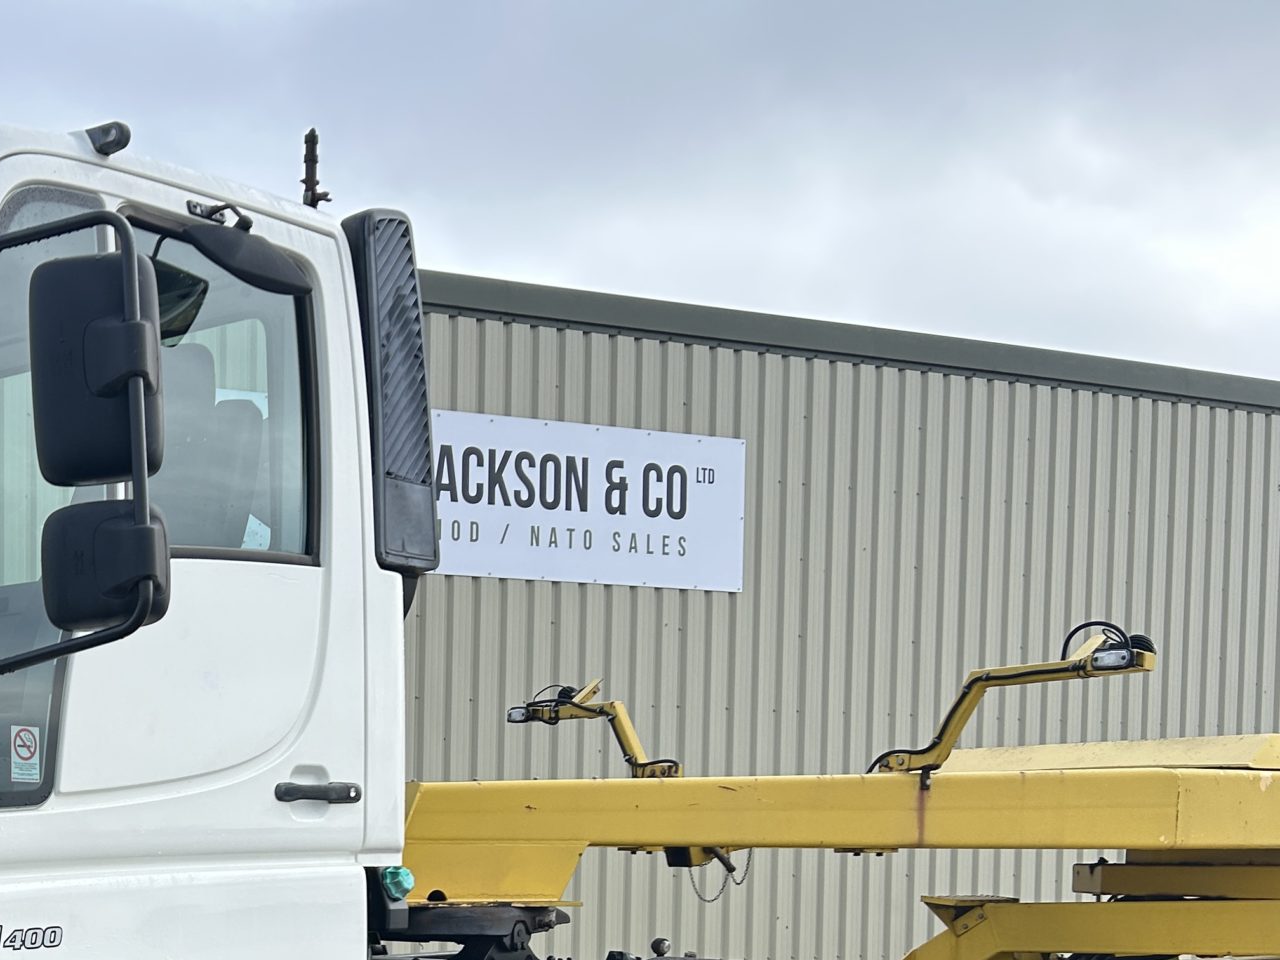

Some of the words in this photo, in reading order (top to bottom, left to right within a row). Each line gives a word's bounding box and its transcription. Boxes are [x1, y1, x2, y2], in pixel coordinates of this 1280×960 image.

[436, 444, 589, 513] ACKSON
[604, 460, 629, 516] &
[642, 462, 687, 520] CO
[696, 466, 715, 484] LTD
[500, 523, 510, 544] /
[530, 525, 593, 550] NATO
[612, 531, 687, 557] SALES
[2, 926, 64, 950] 400
